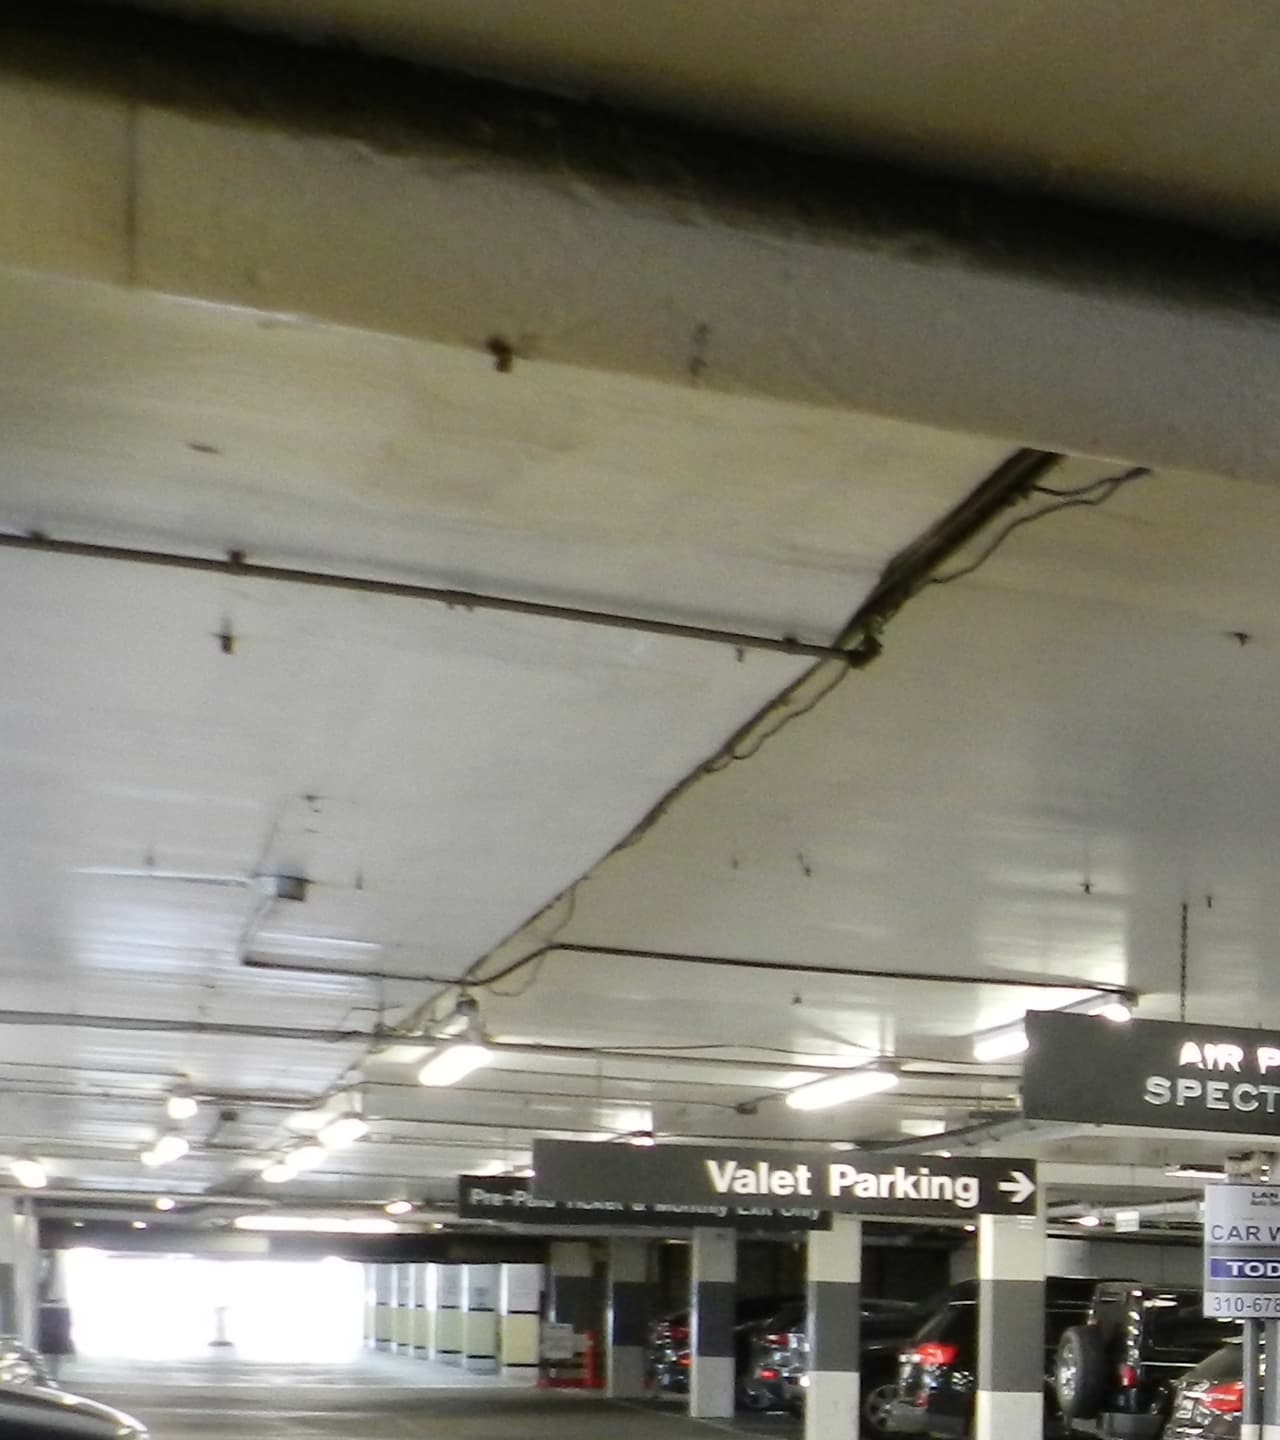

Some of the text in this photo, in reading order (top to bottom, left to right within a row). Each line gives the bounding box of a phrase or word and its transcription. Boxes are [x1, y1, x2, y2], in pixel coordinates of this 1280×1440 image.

[1180, 1041, 1244, 1072] AIR
[705, 1159, 980, 1209] Valet Parking
[1211, 1224, 1261, 1241] CAR
